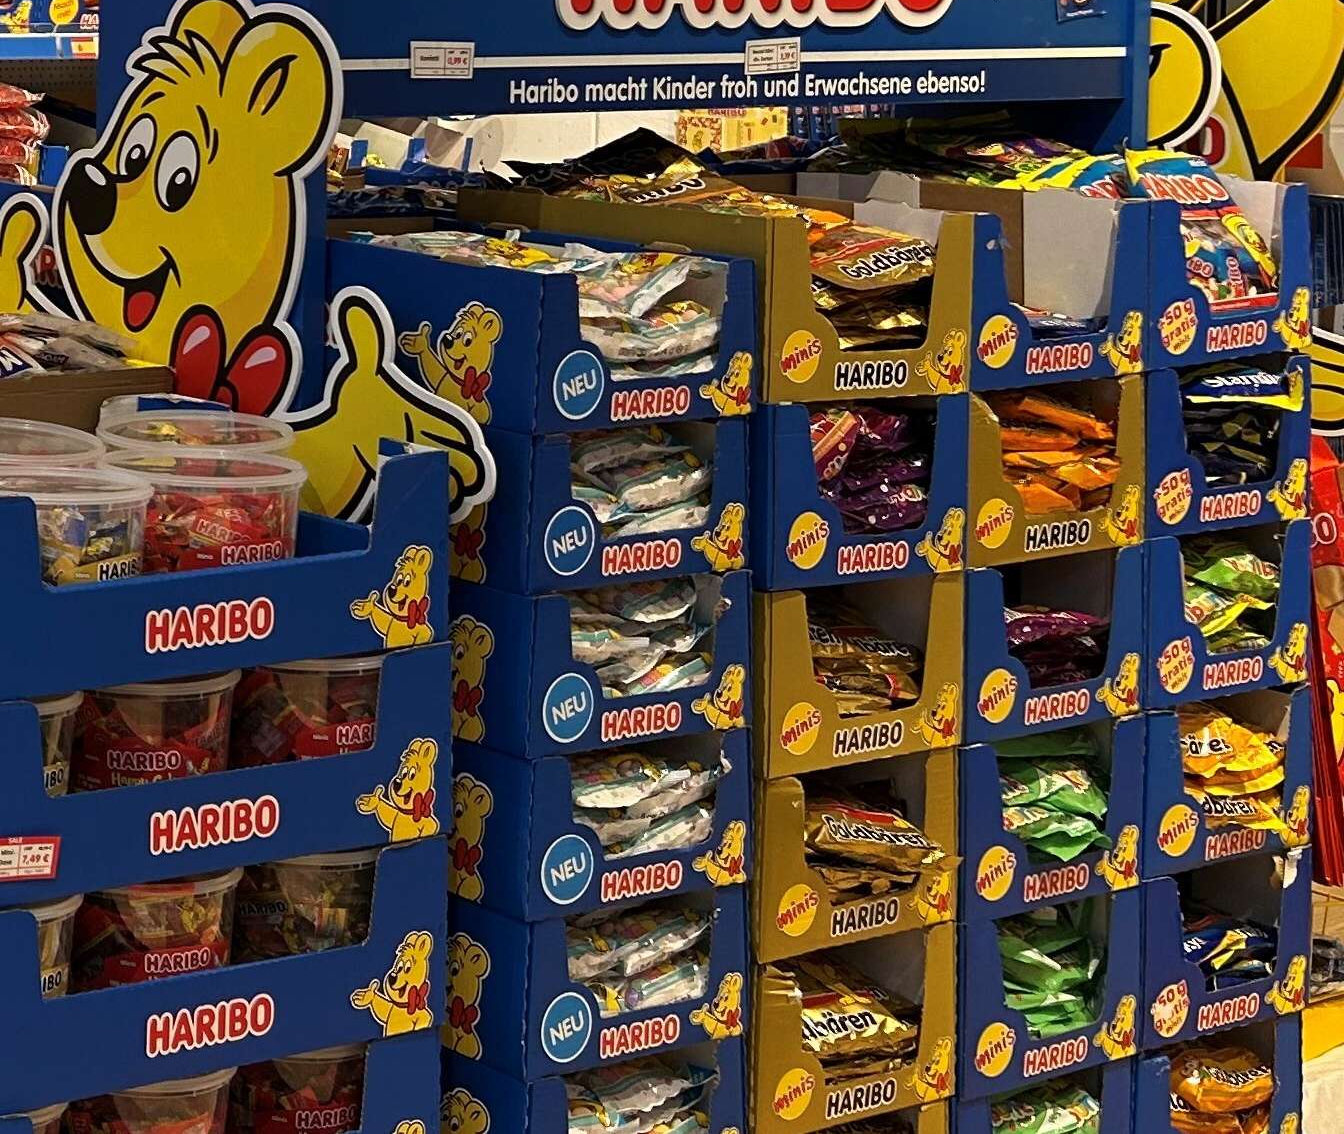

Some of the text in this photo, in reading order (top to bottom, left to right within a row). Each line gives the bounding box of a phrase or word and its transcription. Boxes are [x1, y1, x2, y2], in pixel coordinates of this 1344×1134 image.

[509, 69, 985, 104] Haribo macht Kinder froh und Erwachsene ebenso!
[1143, 173, 1228, 205] HARIBO
[839, 242, 935, 280] Goldbären
[1162, 316, 1197, 346] gratis
[1206, 321, 1267, 353] HARIBO
[1026, 343, 1092, 374] HARIBO
[563, 369, 597, 401] NEU
[835, 361, 907, 391] HARIBO
[611, 386, 691, 420] HARIBO
[1158, 487, 1193, 516] gratis
[1200, 490, 1261, 522] HARIBO
[552, 529, 587, 558] NEU
[1025, 519, 1091, 552] HARIBO
[221, 542, 282, 564] HARIBO
[603, 539, 681, 576] HARIBO
[838, 541, 910, 575] HARIBO
[148, 598, 273, 652] HARIBO
[1161, 655, 1195, 683] gratis
[1204, 656, 1263, 689] HARIBO
[552, 699, 586, 725] NEU
[602, 702, 682, 741] HARIBO
[1025, 690, 1090, 726] HARIBO
[834, 720, 903, 756] HARIBO
[107, 751, 181, 771] HARIBO
[151, 796, 277, 855] HARIBO
[824, 815, 925, 848] Goldbären
[23, 854, 40, 865] 7,49
[1205, 834, 1266, 861] HARIBO
[551, 857, 585, 886] NEU
[601, 860, 682, 901] HARIBO
[1024, 864, 1089, 902] HARIBO
[830, 898, 898, 936] HARIBO
[145, 948, 211, 974] HARIBO
[148, 994, 273, 1056] HARIBO
[549, 1011, 584, 1042] NEU
[1198, 993, 1260, 1032] HARIBO
[600, 1014, 679, 1058] HARIBO
[1024, 1037, 1087, 1077] HARIBO
[826, 1078, 896, 1119] HARIBO
